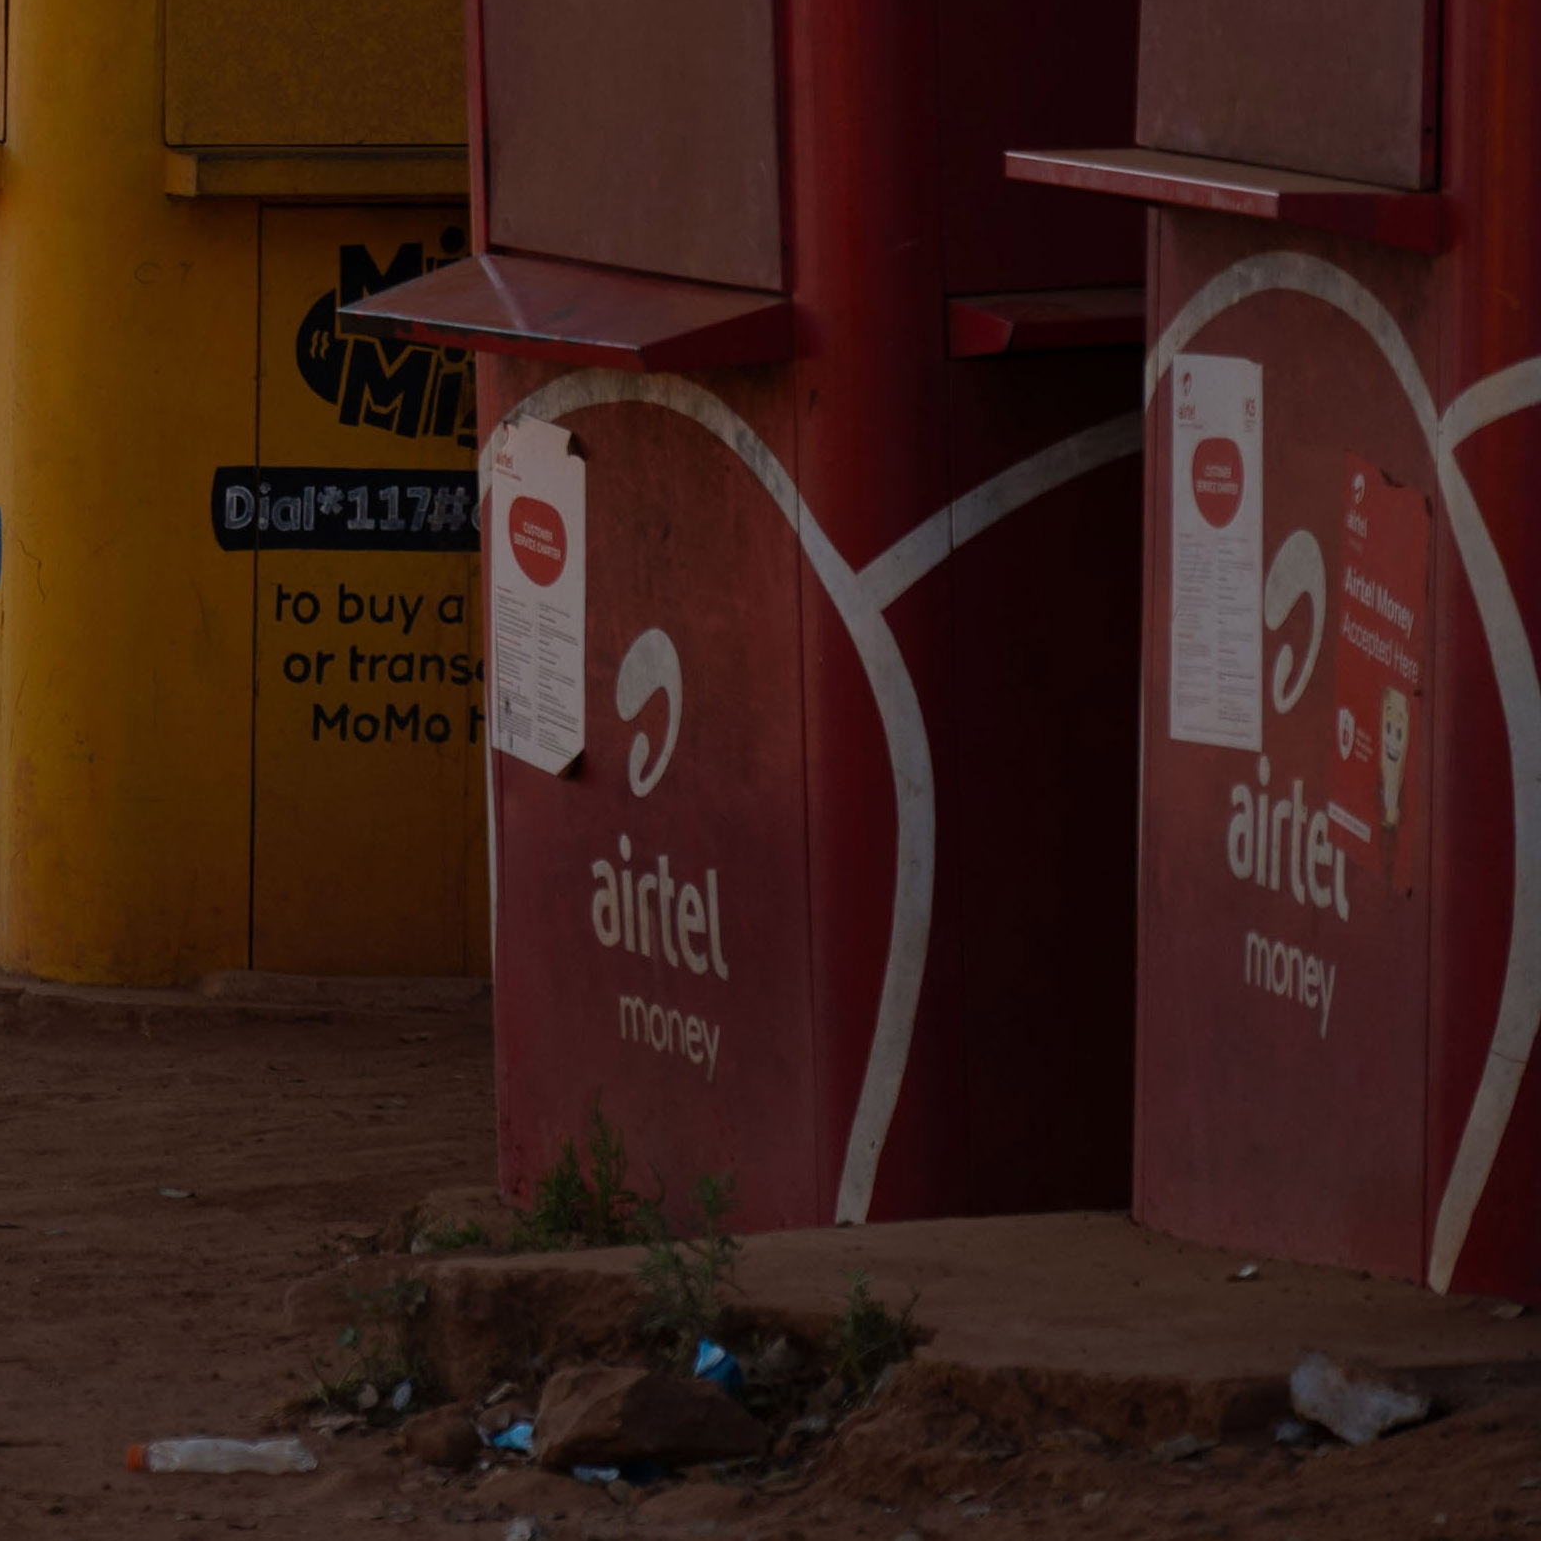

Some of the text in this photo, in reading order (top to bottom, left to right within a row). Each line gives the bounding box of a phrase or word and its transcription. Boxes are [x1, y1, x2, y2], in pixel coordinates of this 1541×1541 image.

[274, 582, 465, 636] to buy a
[1344, 565, 1415, 642] Airtel Money
[282, 650, 336, 685] or
[1342, 611, 1420, 685] Accepted Here
[311, 702, 453, 744] MoMo
[1226, 755, 1350, 924] airtel
[590, 834, 728, 984] airtel
[1244, 927, 1337, 1041] money
[618, 990, 720, 1084] money
